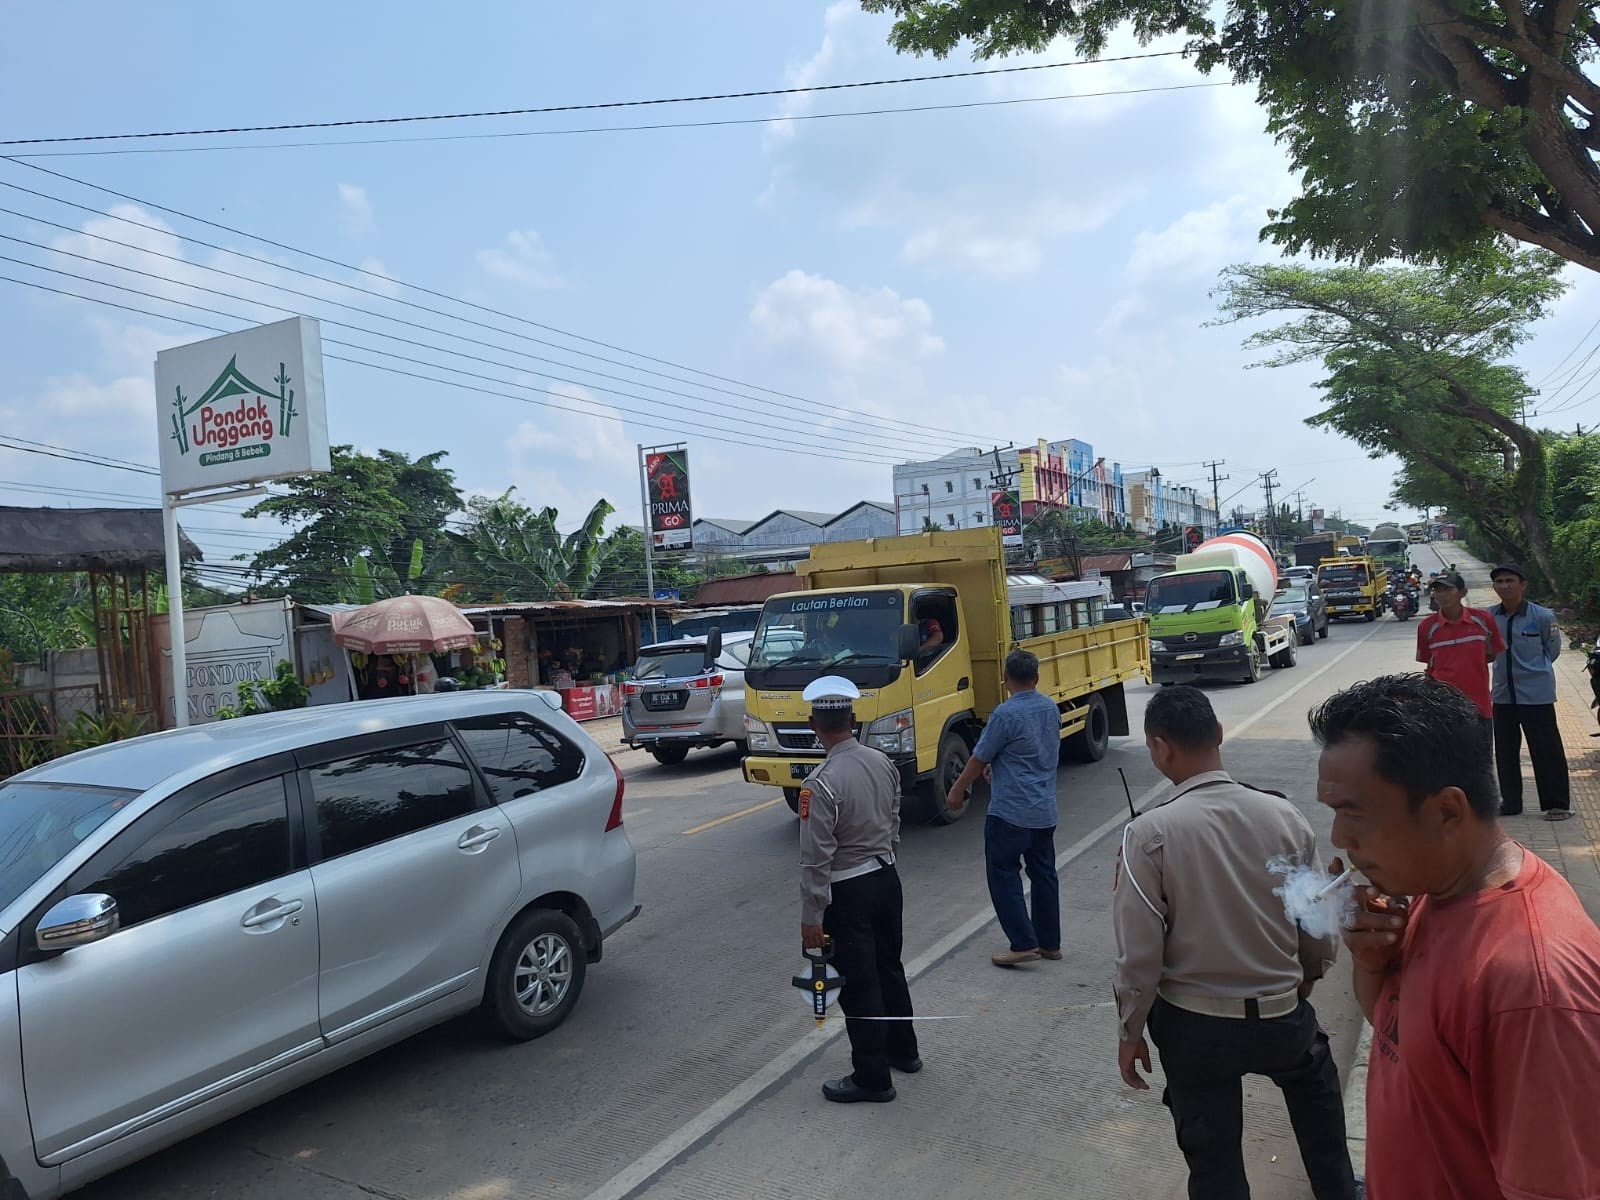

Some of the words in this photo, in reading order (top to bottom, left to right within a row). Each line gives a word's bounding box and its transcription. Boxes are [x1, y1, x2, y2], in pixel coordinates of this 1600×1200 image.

[201, 396, 268, 427] Pondok
[192, 419, 273, 448] Unggang
[205, 453, 233, 463] Pindang
[241, 446, 264, 456] Bebek
[652, 500, 689, 515] PRIMA
[664, 516, 680, 526] GO
[791, 600, 827, 612] Lautan
[830, 597, 869, 607] Berlian
[186, 662, 262, 688] PONDOK
